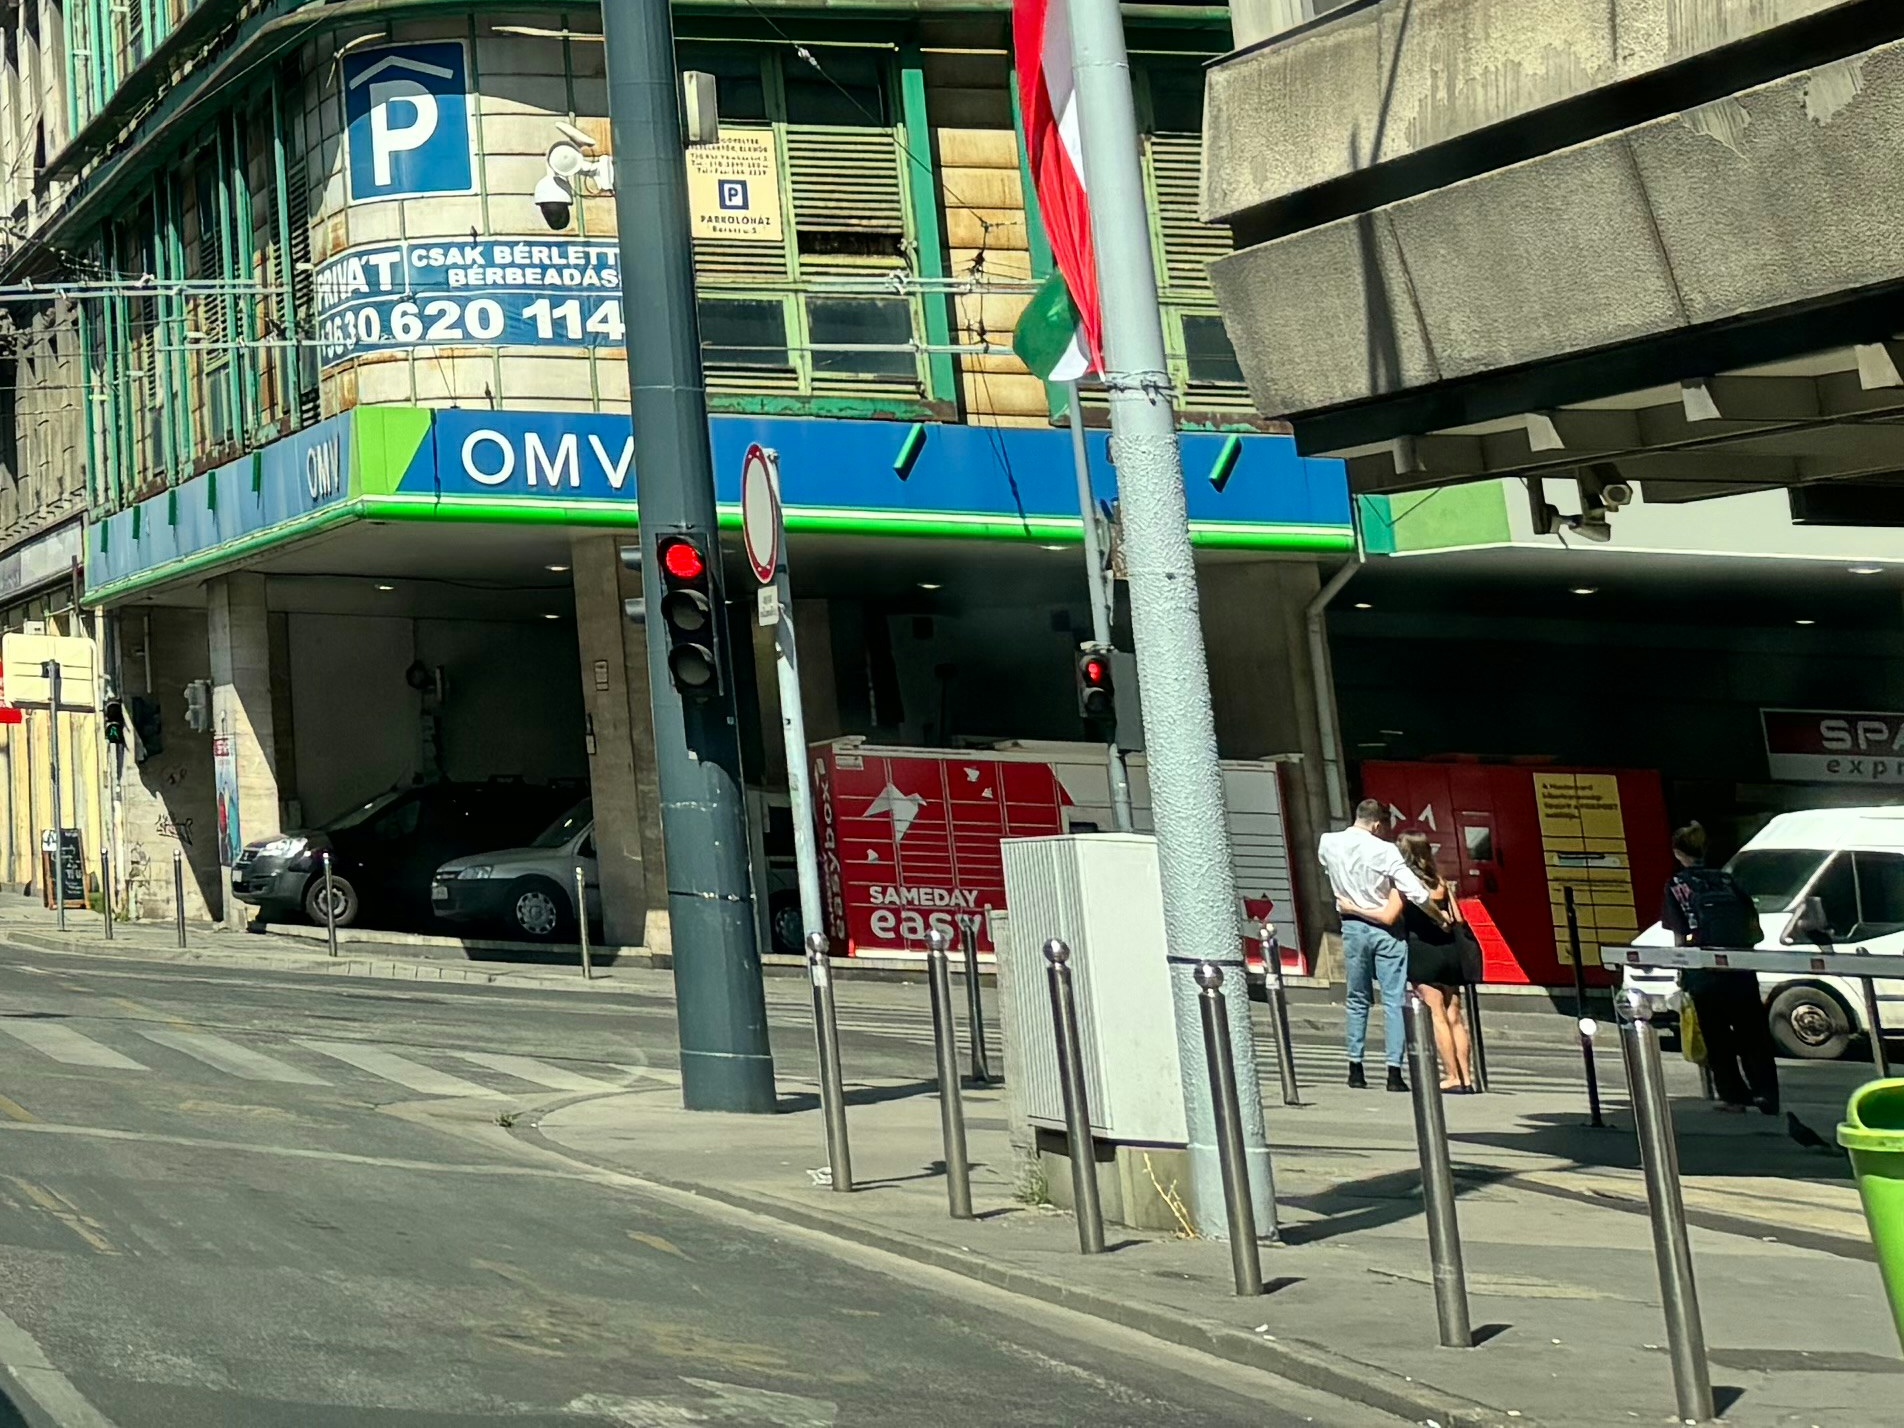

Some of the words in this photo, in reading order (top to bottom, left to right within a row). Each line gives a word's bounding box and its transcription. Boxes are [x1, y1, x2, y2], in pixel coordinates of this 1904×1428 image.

[369, 79, 439, 187] P
[410, 246, 486, 267] CSAK
[447, 266, 620, 287] BÉRBEADÁS
[390, 298, 505, 343] 620
[306, 436, 341, 500] OMV
[461, 429, 635, 489] OMV
[869, 886, 978, 907] SAMEDAY
